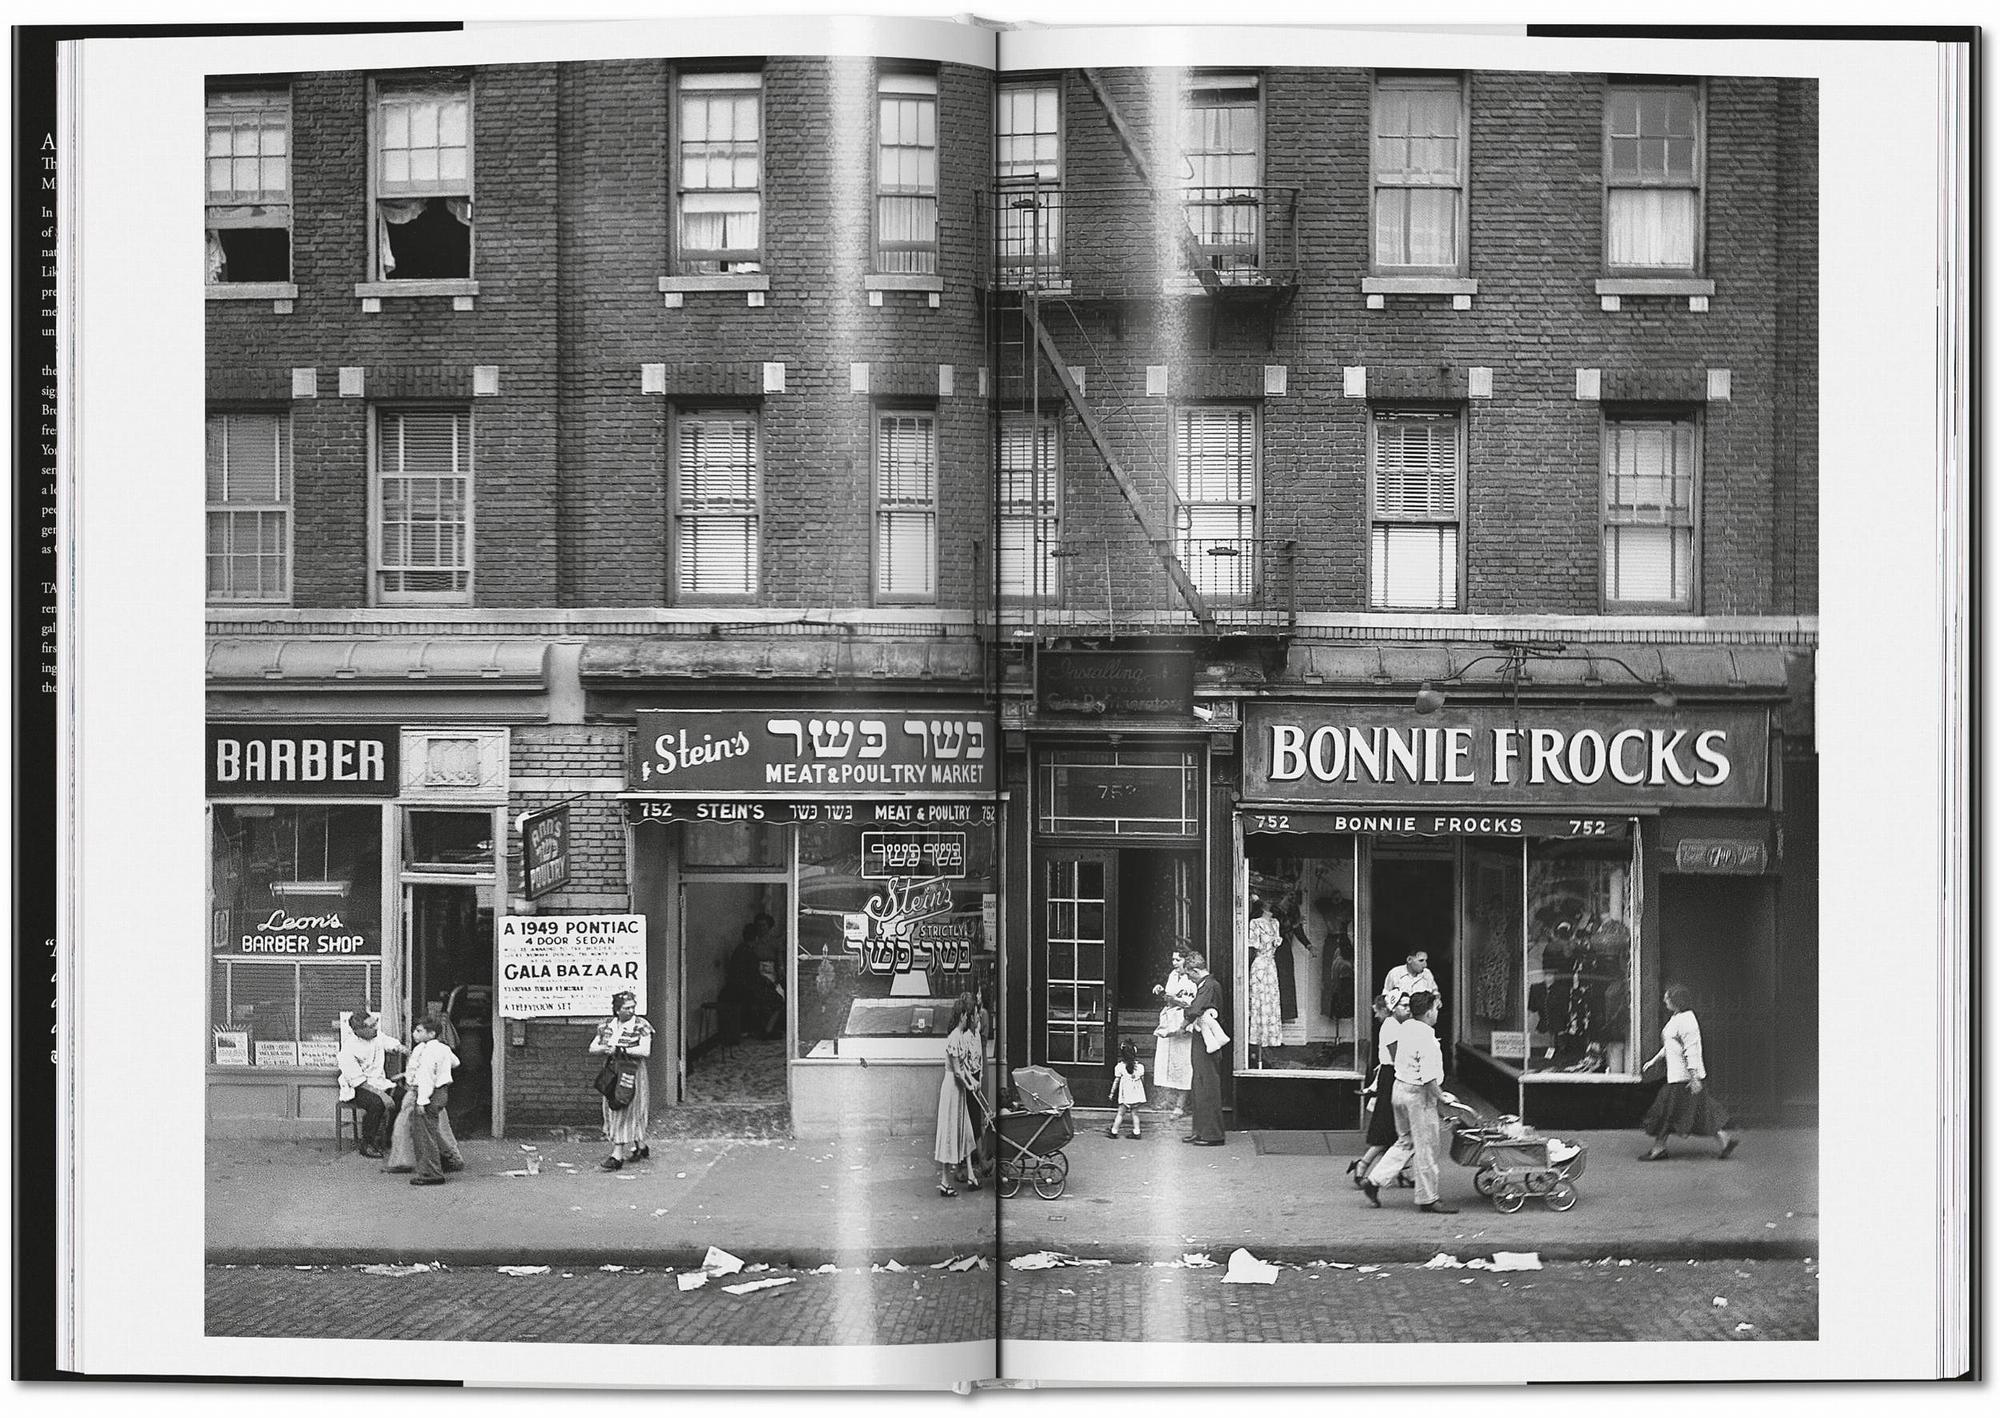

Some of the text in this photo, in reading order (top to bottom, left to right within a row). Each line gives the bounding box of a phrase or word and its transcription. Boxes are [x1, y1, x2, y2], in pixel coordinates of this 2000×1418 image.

[41, 206, 53, 217] In
[41, 226, 54, 237] of
[41, 327, 57, 337] un
[41, 385, 57, 399] sig
[41, 487, 48, 495] a
[216, 739, 385, 782] BARBER
[655, 729, 750, 774] Stein's
[1268, 725, 1731, 787] BONNIE FROCKS
[931, 764, 984, 784] MARKET
[640, 802, 765, 820] 752 STEIN'S
[875, 804, 971, 821] MEAT & POULTRY
[981, 805, 996, 821] 752
[1255, 815, 1606, 835] 752 BONNIE FROCKS 752
[863, 876, 953, 936] Stein's
[256, 909, 344, 932] Leon's
[504, 921, 639, 935] A 1949 PONTIAC
[241, 935, 365, 953] BARBER SHOP
[525, 936, 615, 945] 4 DOOR SEDAN
[504, 961, 639, 980] GALA BAZAAR
